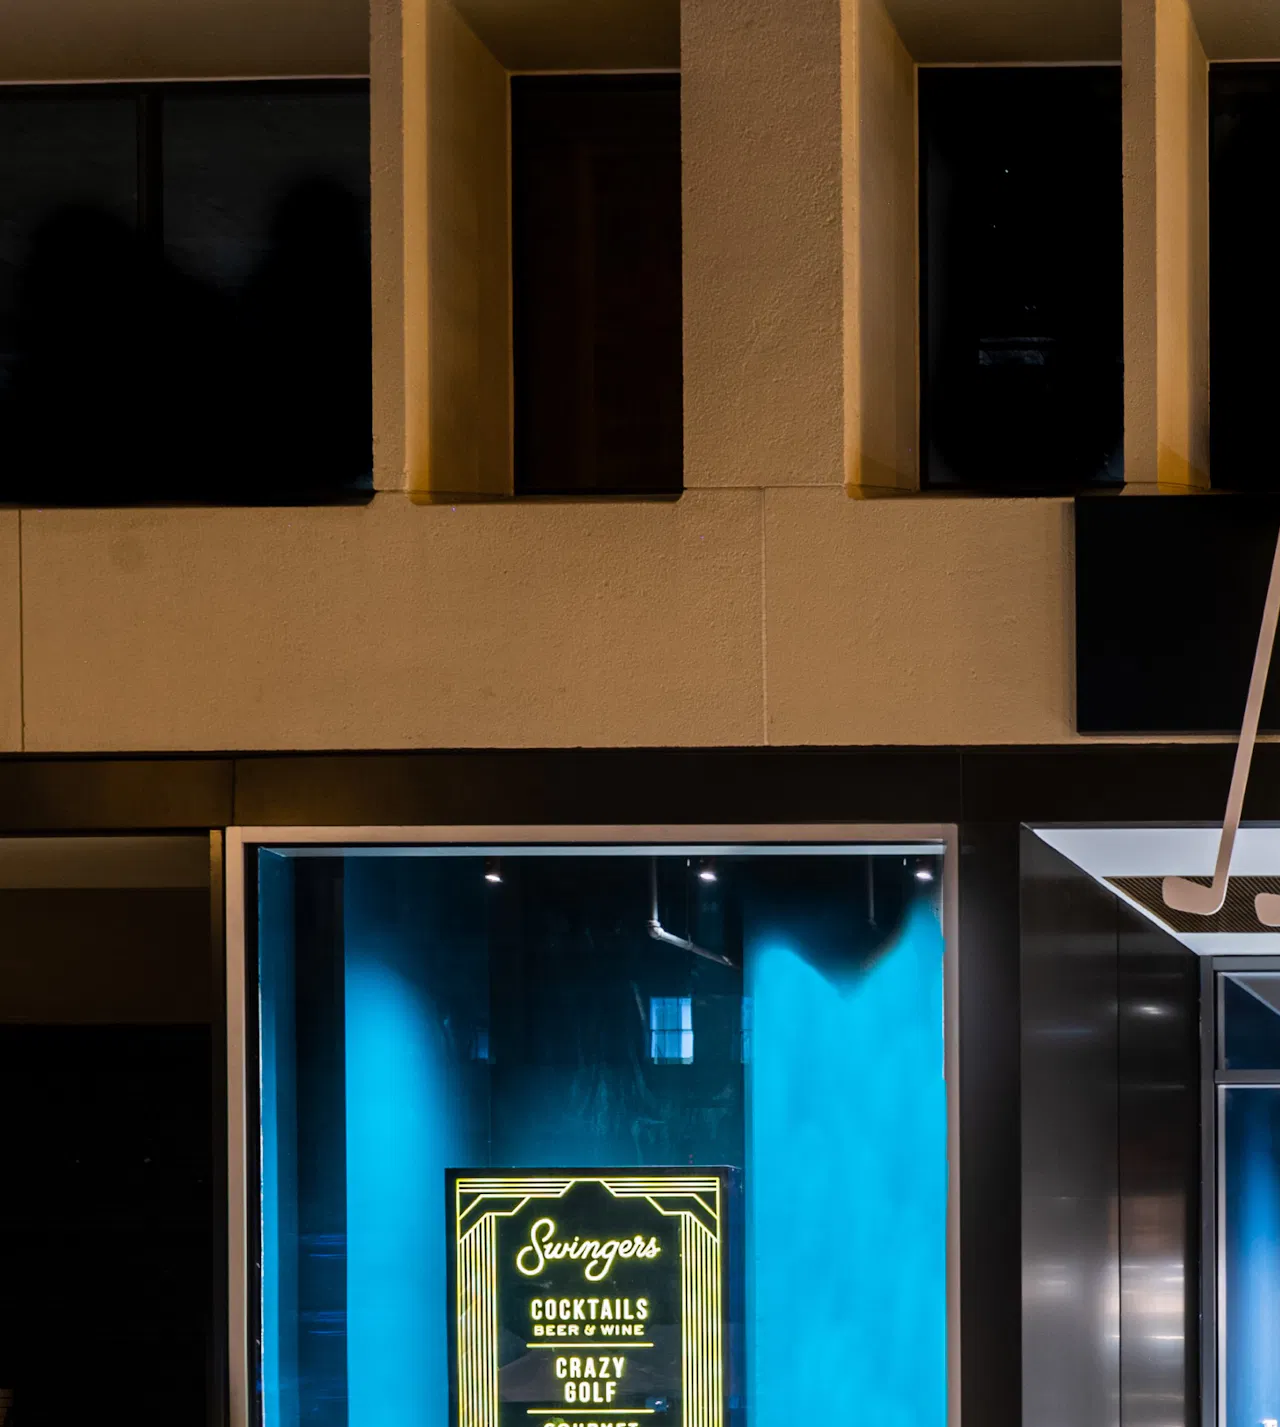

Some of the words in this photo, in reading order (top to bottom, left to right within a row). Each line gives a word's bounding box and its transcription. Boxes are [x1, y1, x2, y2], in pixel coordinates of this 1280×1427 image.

[516, 1218, 661, 1281] Swingers
[530, 1298, 649, 1321] COCKTAILS
[533, 1324, 580, 1337] BEER
[583, 1324, 597, 1337] &
[599, 1324, 645, 1336] WINE
[555, 1357, 626, 1382] CRAZY
[563, 1380, 618, 1404] GOLF
